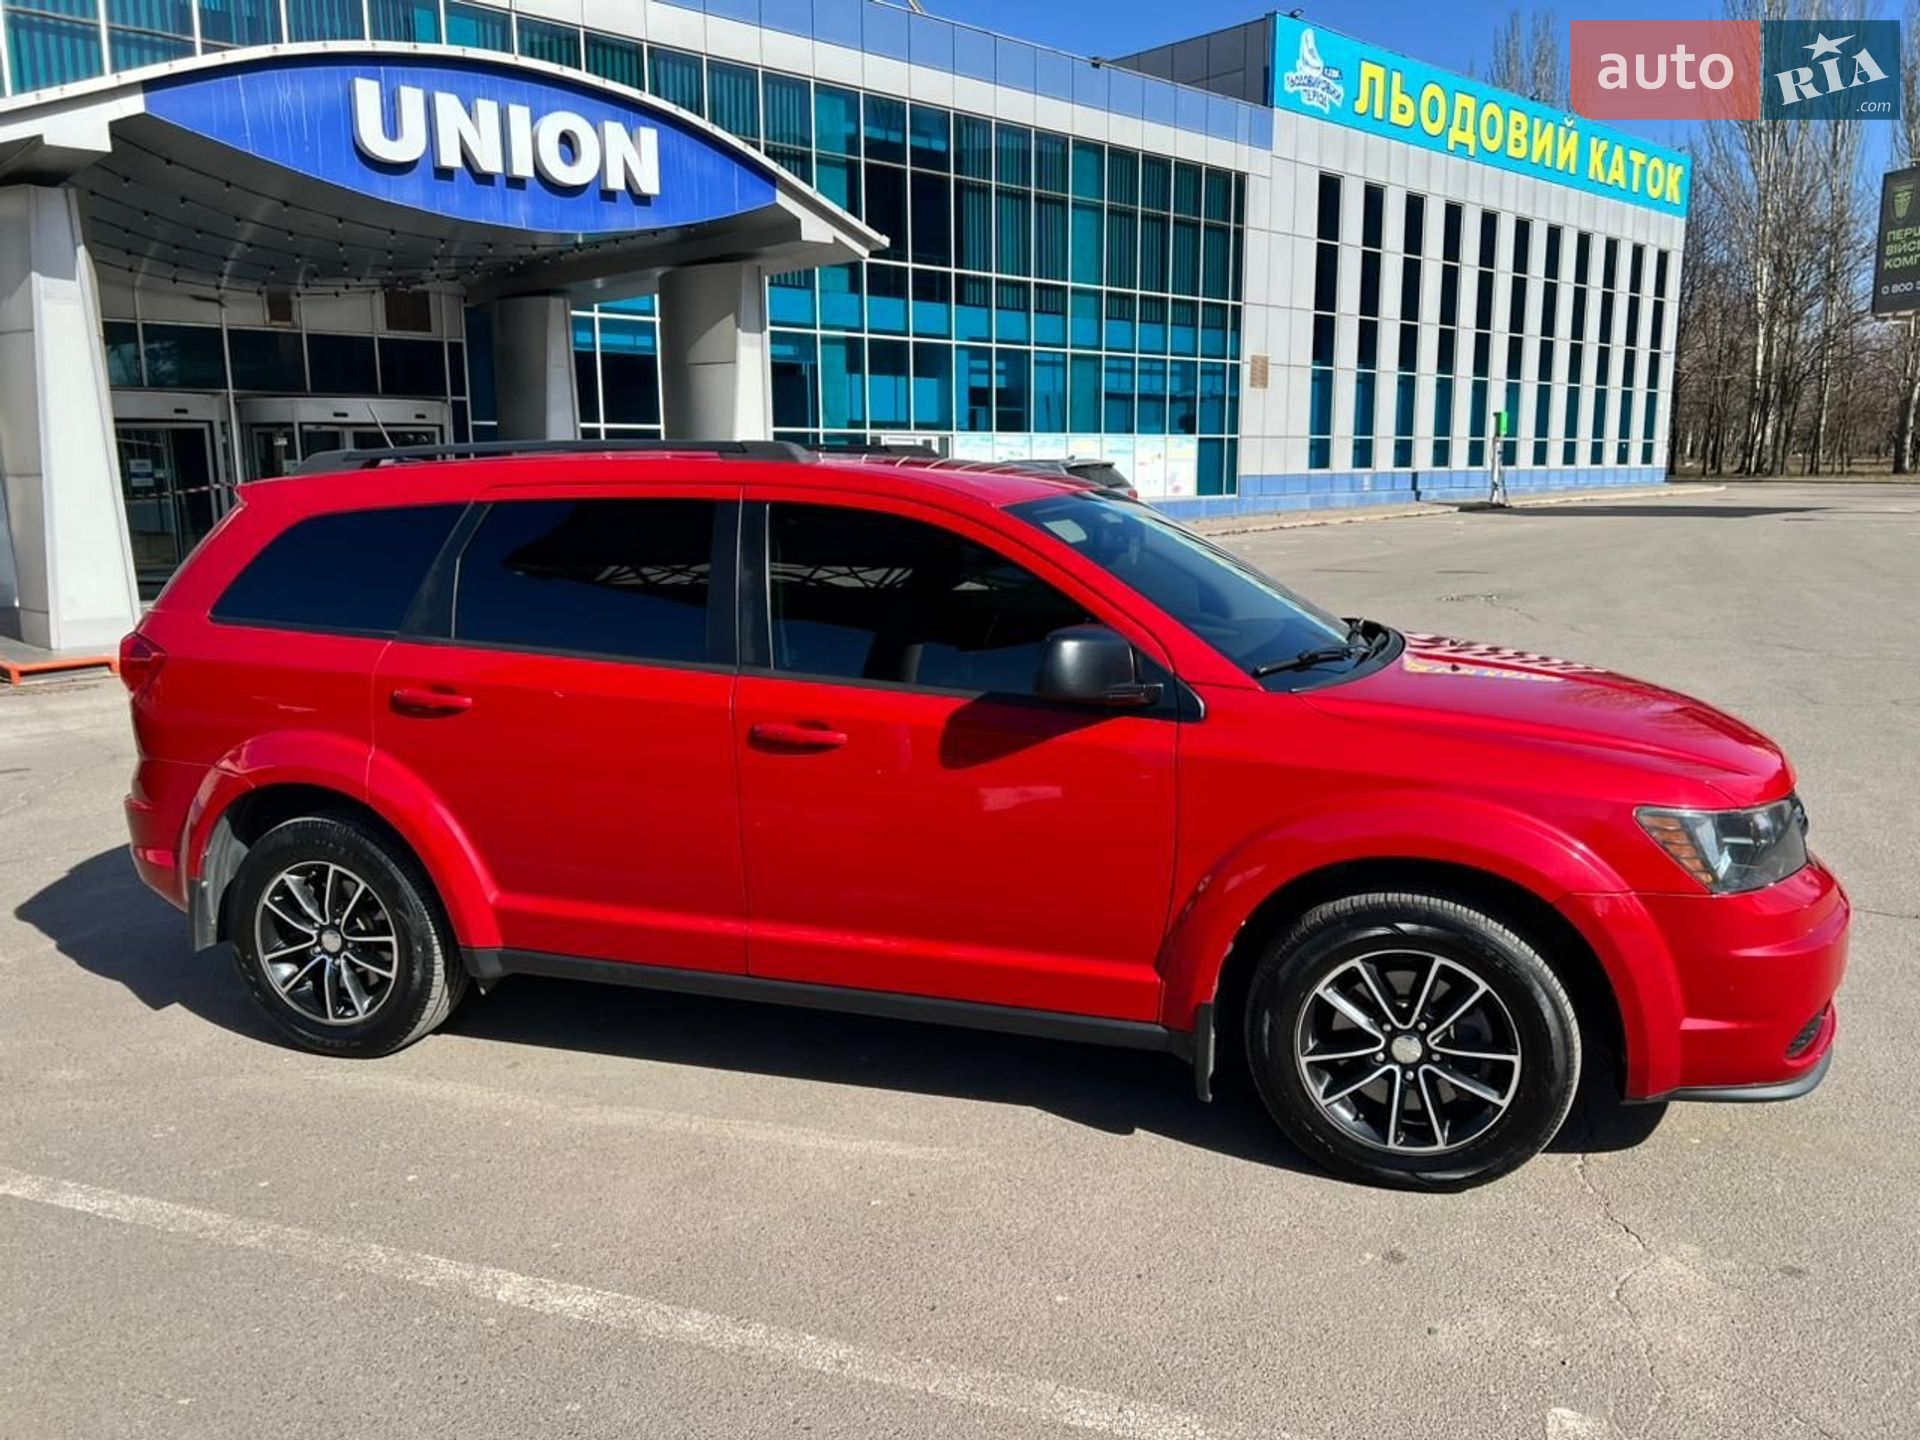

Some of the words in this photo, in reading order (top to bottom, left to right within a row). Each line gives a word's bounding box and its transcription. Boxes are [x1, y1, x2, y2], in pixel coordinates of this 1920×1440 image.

[353, 77, 660, 196] UNION
[1353, 60, 1578, 176] ЛЬОДОВИЙ
[1587, 136, 1684, 206] КАТОК
[1885, 239, 1920, 256] ВІЙС
